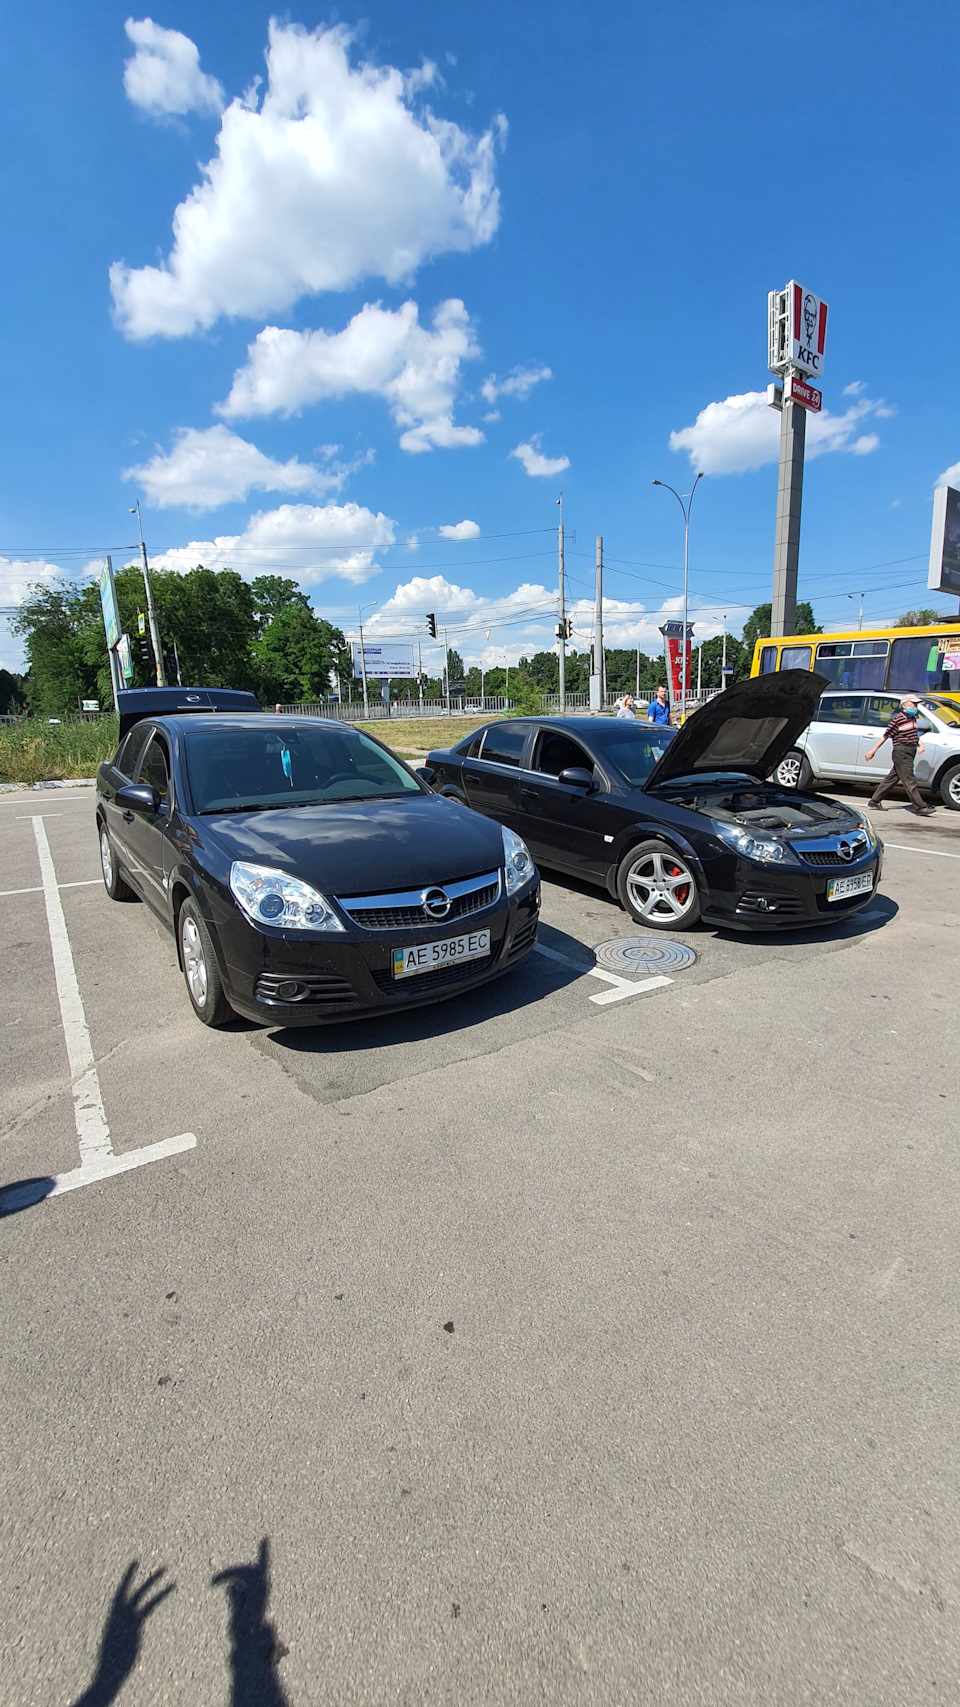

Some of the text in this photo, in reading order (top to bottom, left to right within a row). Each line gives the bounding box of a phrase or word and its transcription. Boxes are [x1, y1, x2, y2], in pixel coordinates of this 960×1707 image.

[797, 345, 819, 369] KFC
[792, 382, 810, 400] DRIVE
[939, 639, 950, 651] 217
[835, 881, 845, 895] AE
[406, 947, 427, 968] AE
[432, 939, 465, 961] 5985
[468, 933, 487, 952] EC
